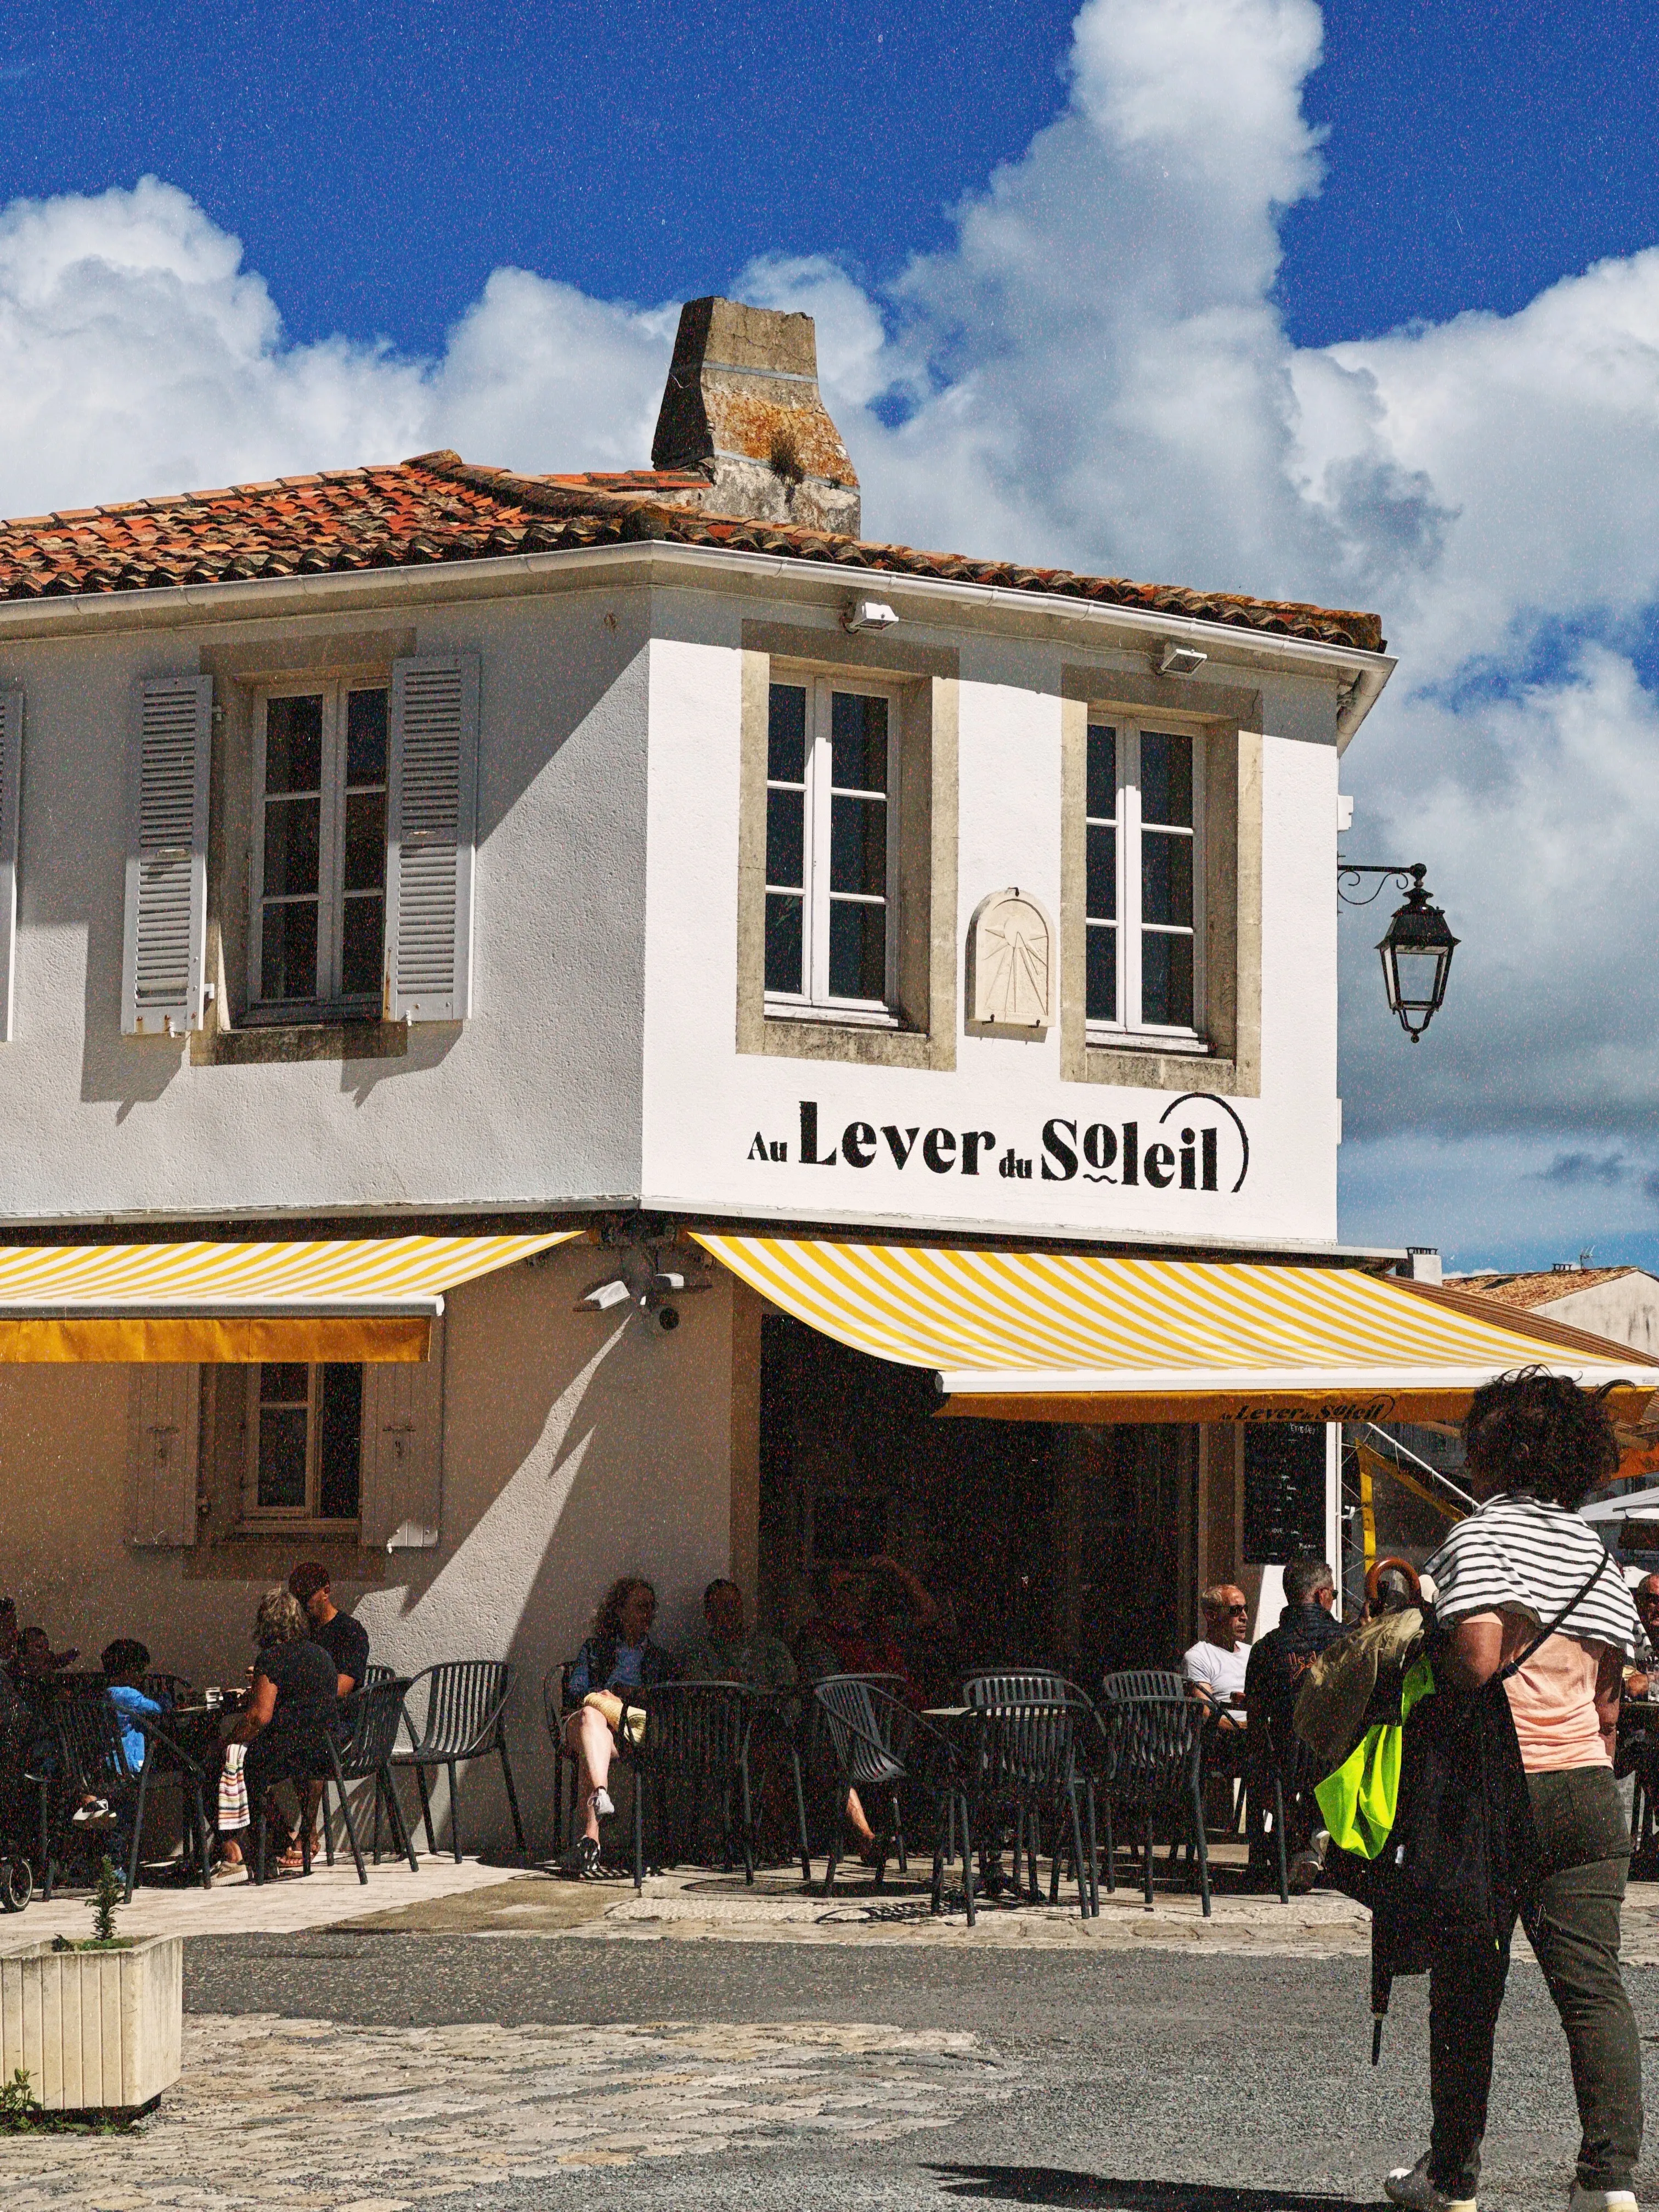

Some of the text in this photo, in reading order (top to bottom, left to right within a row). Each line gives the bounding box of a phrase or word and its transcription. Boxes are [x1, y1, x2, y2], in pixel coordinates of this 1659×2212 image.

[747, 1101, 1218, 1193] Au Lever du Soleil
[1235, 1404, 1305, 1420] Lever
[1315, 1403, 1385, 1421] Soleil
